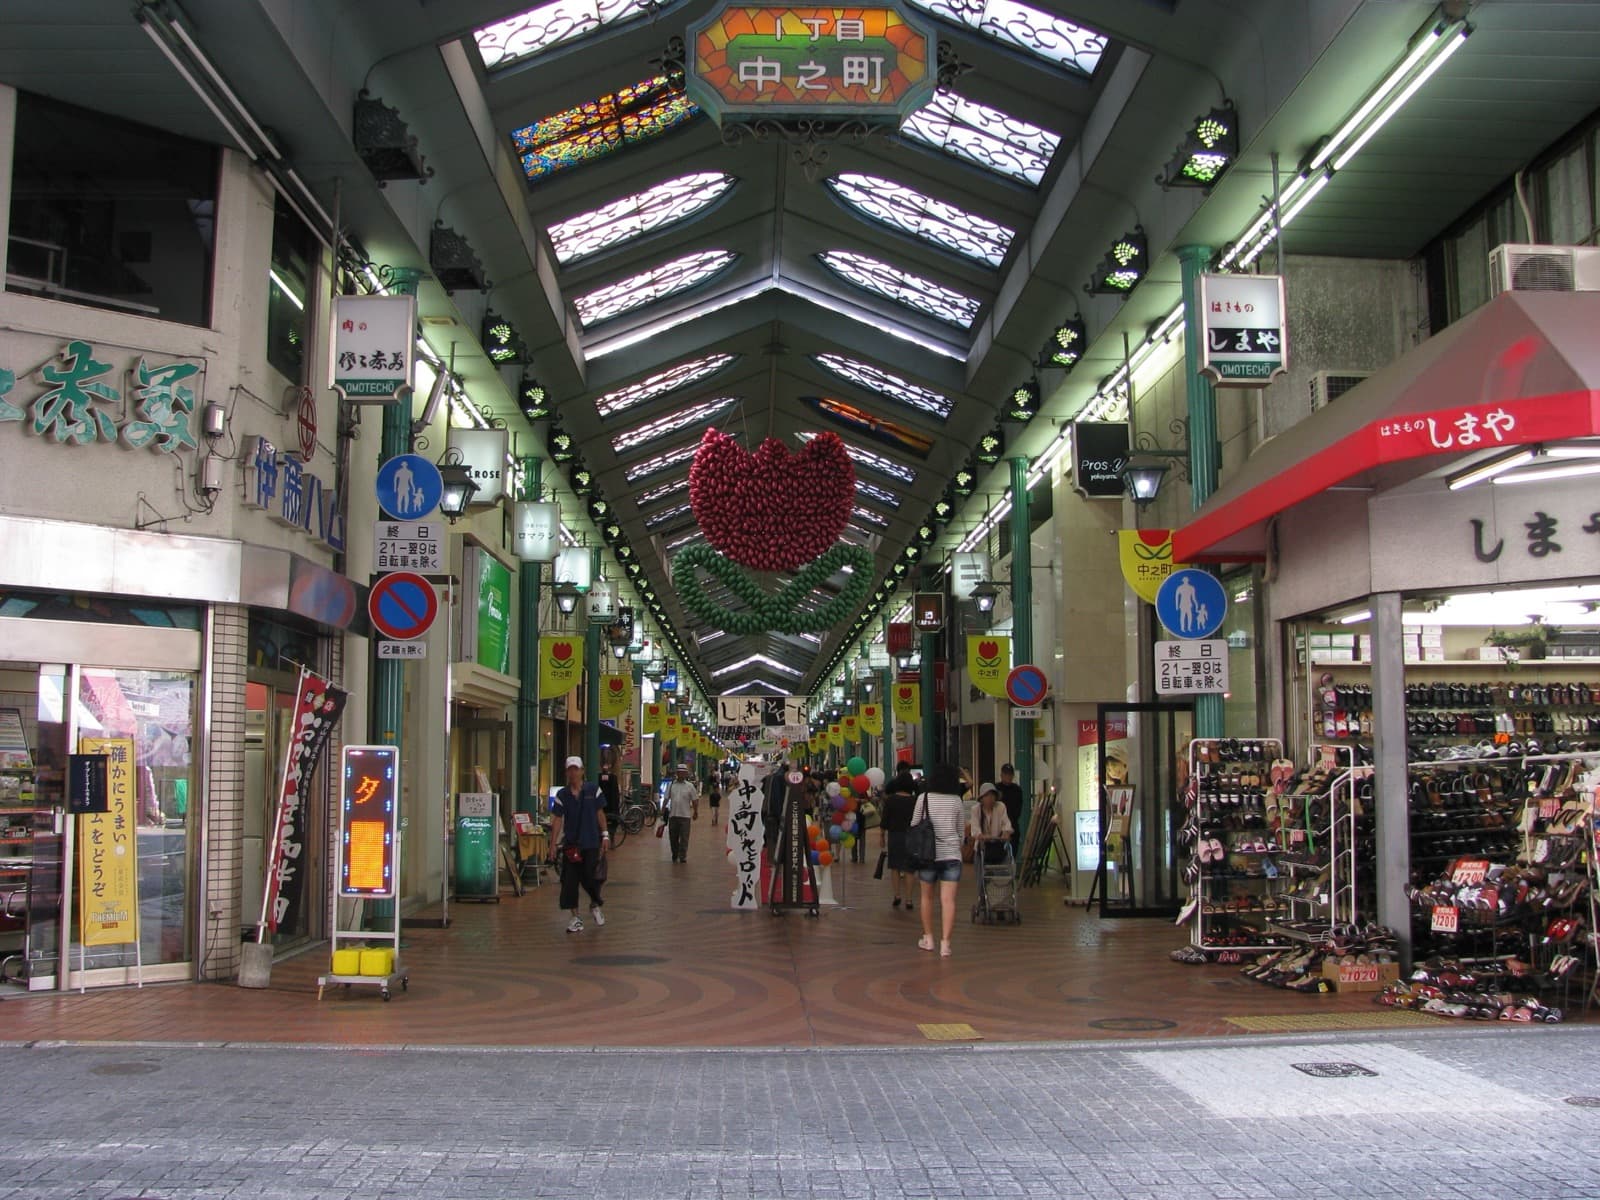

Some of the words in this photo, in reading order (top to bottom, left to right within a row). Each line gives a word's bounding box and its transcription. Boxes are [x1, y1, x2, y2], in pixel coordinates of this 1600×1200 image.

[738, 55, 885, 94] 中之町
[1211, 301, 1254, 313] はきもの
[1209, 329, 1279, 352] しまや
[1380, 419, 1424, 436] はきもの
[1427, 408, 1515, 448] しまや
[518, 532, 555, 540] ロマラン
[379, 555, 437, 568] 自転車を除く
[1137, 563, 1173, 577] 中之町
[1161, 675, 1223, 689] 自転車を除く
[111, 746, 128, 843] 確かにうまい
[90, 747, 106, 898] ムをどうぞ
